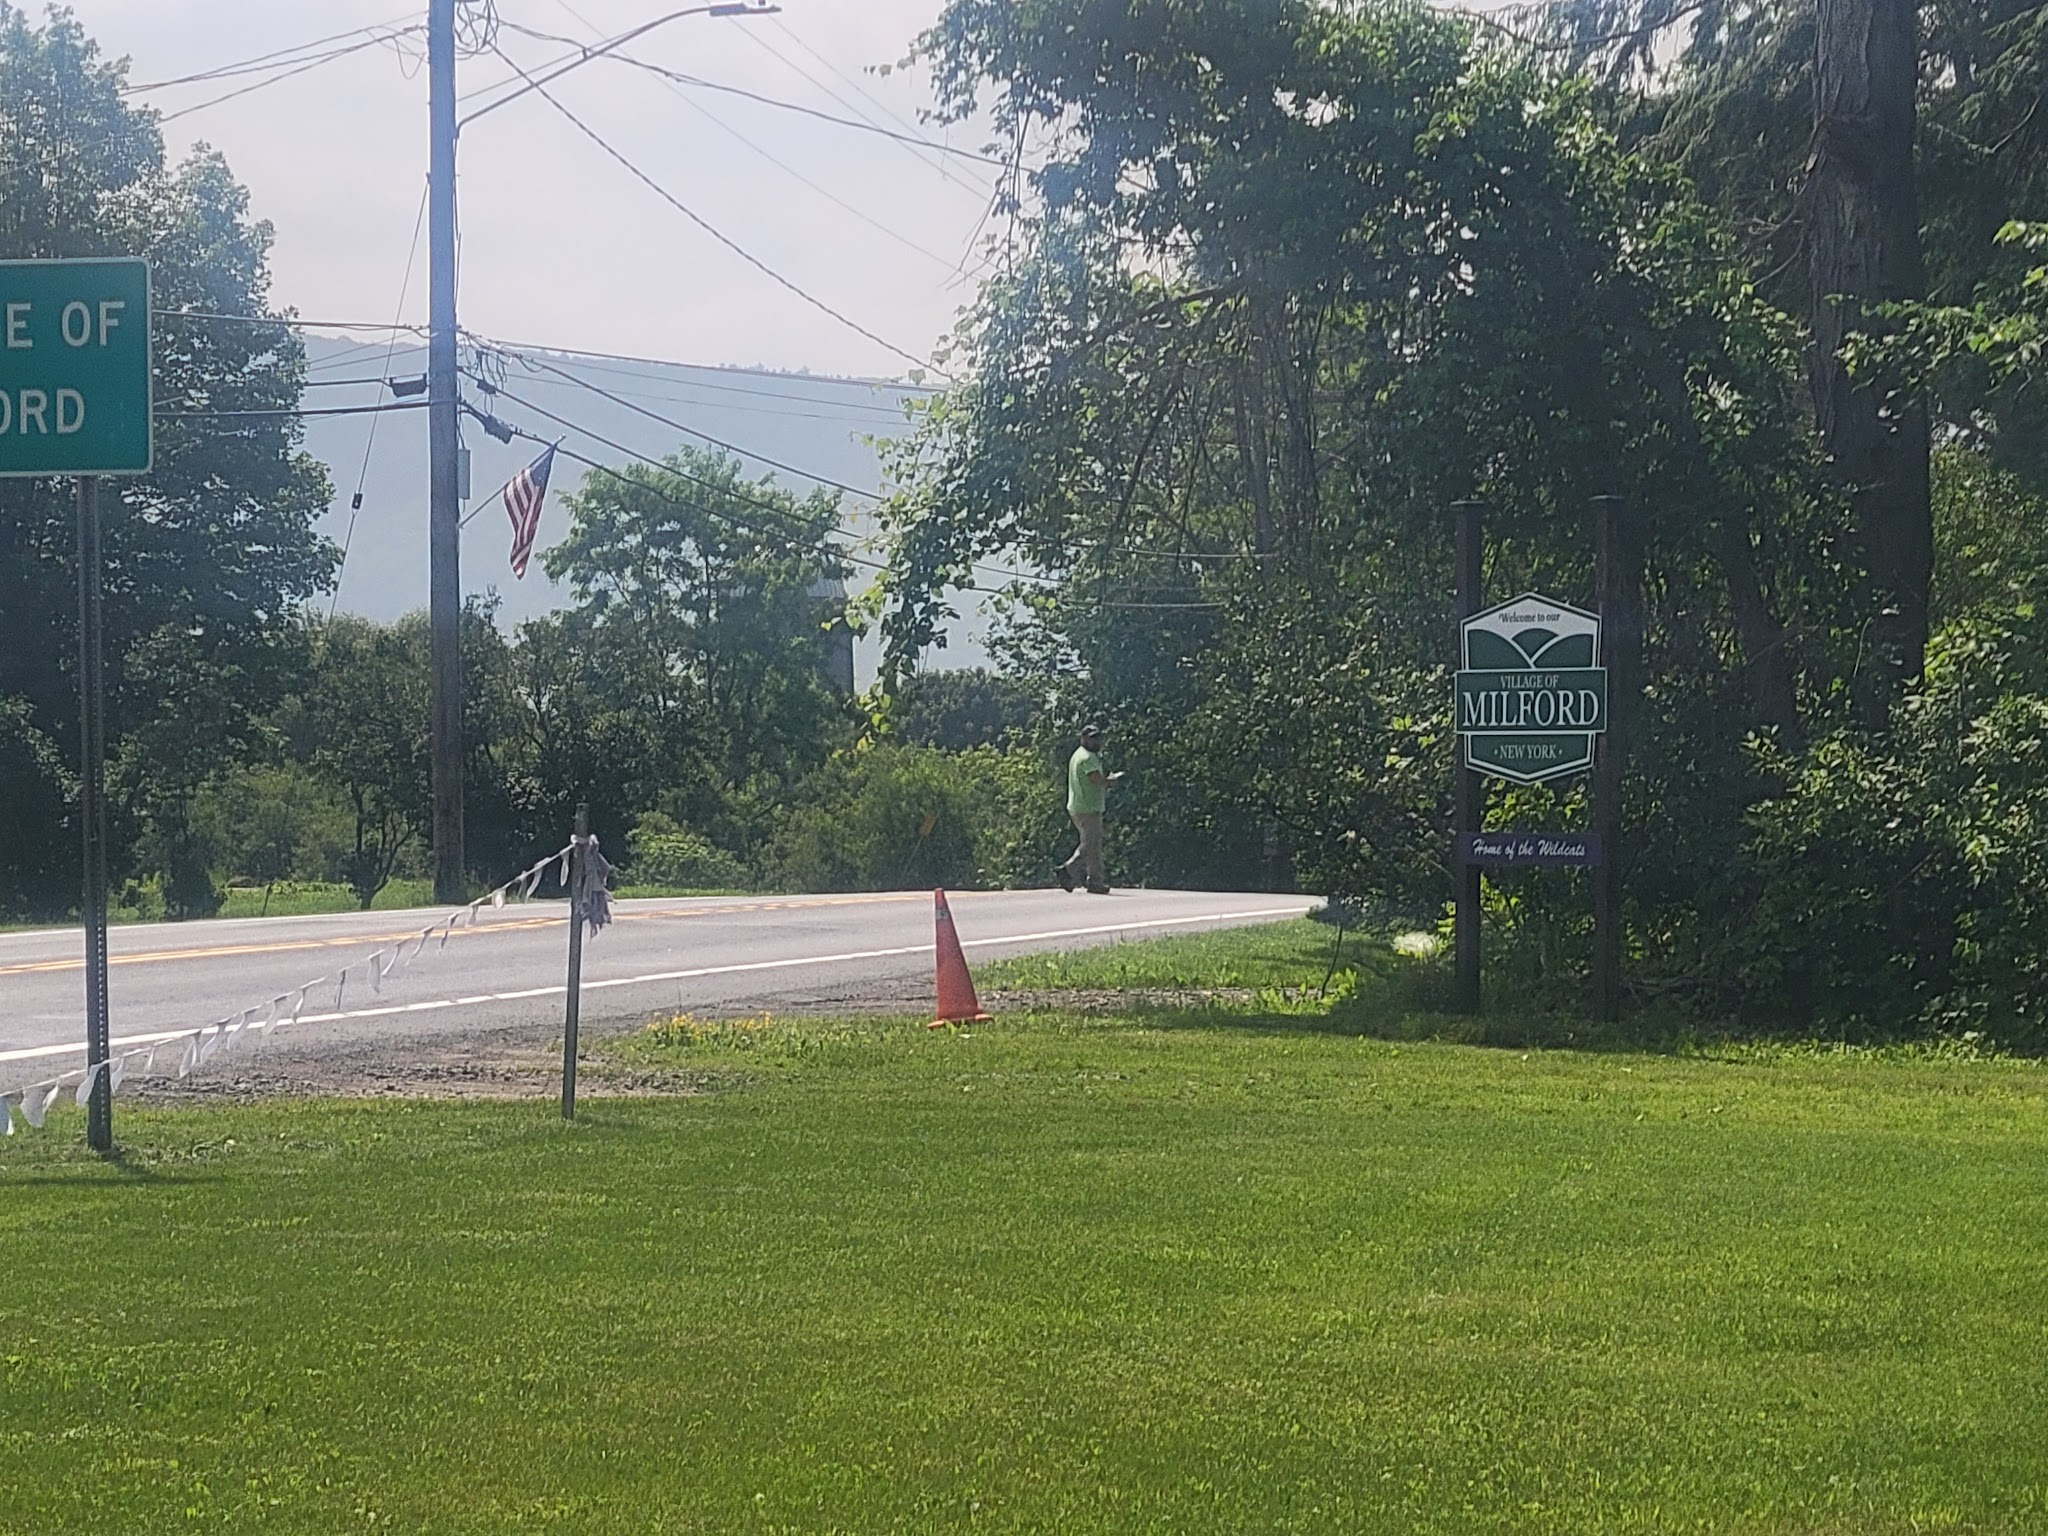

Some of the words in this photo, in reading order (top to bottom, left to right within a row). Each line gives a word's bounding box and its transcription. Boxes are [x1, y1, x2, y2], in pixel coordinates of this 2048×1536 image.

[61, 301, 125, 347] OF
[1499, 611, 1536, 623] Welcome
[1538, 612, 1545, 622] to
[1547, 613, 1560, 622] our
[1501, 675, 1542, 689] VILLAGE
[1545, 675, 1559, 688] OF
[1463, 689, 1599, 727] MILFORD
[1500, 745, 1526, 759] NEW
[1527, 745, 1556, 759] YORK
[1472, 838, 1501, 855] Home
[1505, 840, 1516, 860] of
[1518, 840, 1534, 856] the
[1538, 839, 1585, 857] Wildcats
